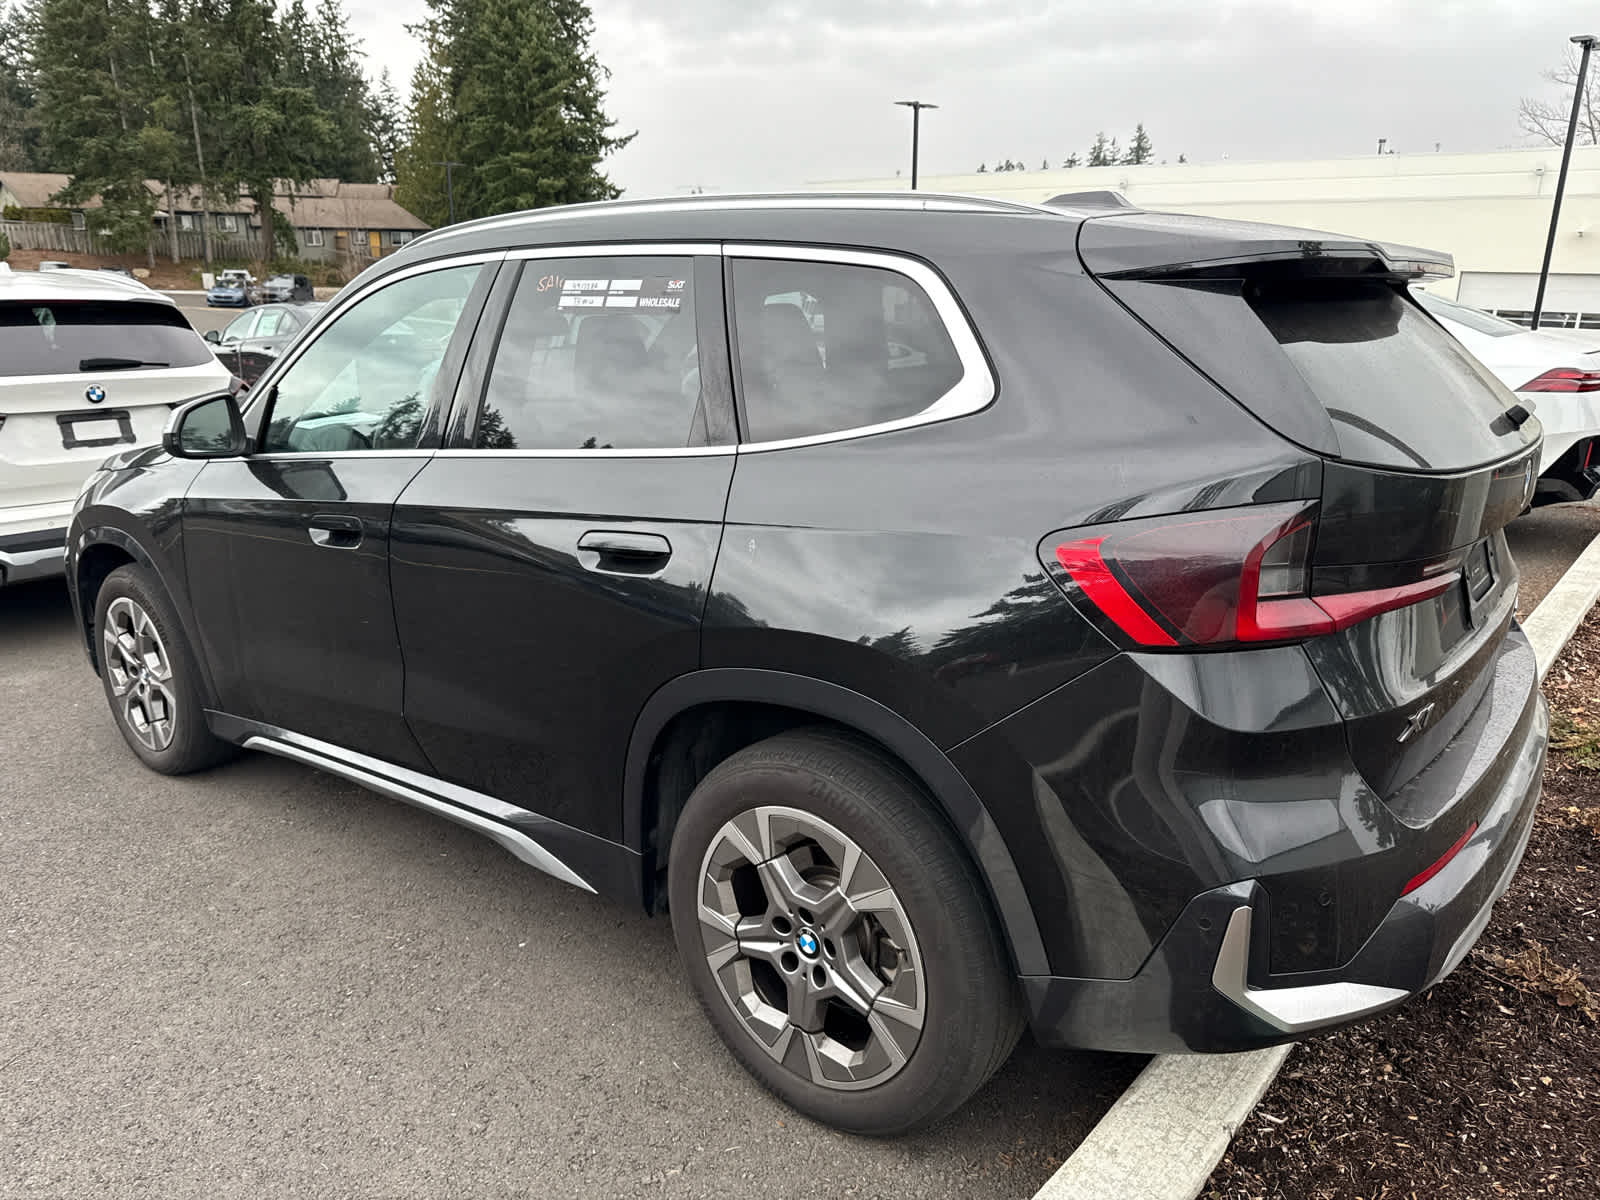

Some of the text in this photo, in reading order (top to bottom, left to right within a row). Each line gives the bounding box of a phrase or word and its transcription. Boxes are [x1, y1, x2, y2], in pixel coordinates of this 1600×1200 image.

[667, 279, 686, 289] SIXT
[639, 297, 681, 308] WHOLESALE
[1396, 703, 1436, 743] X1
